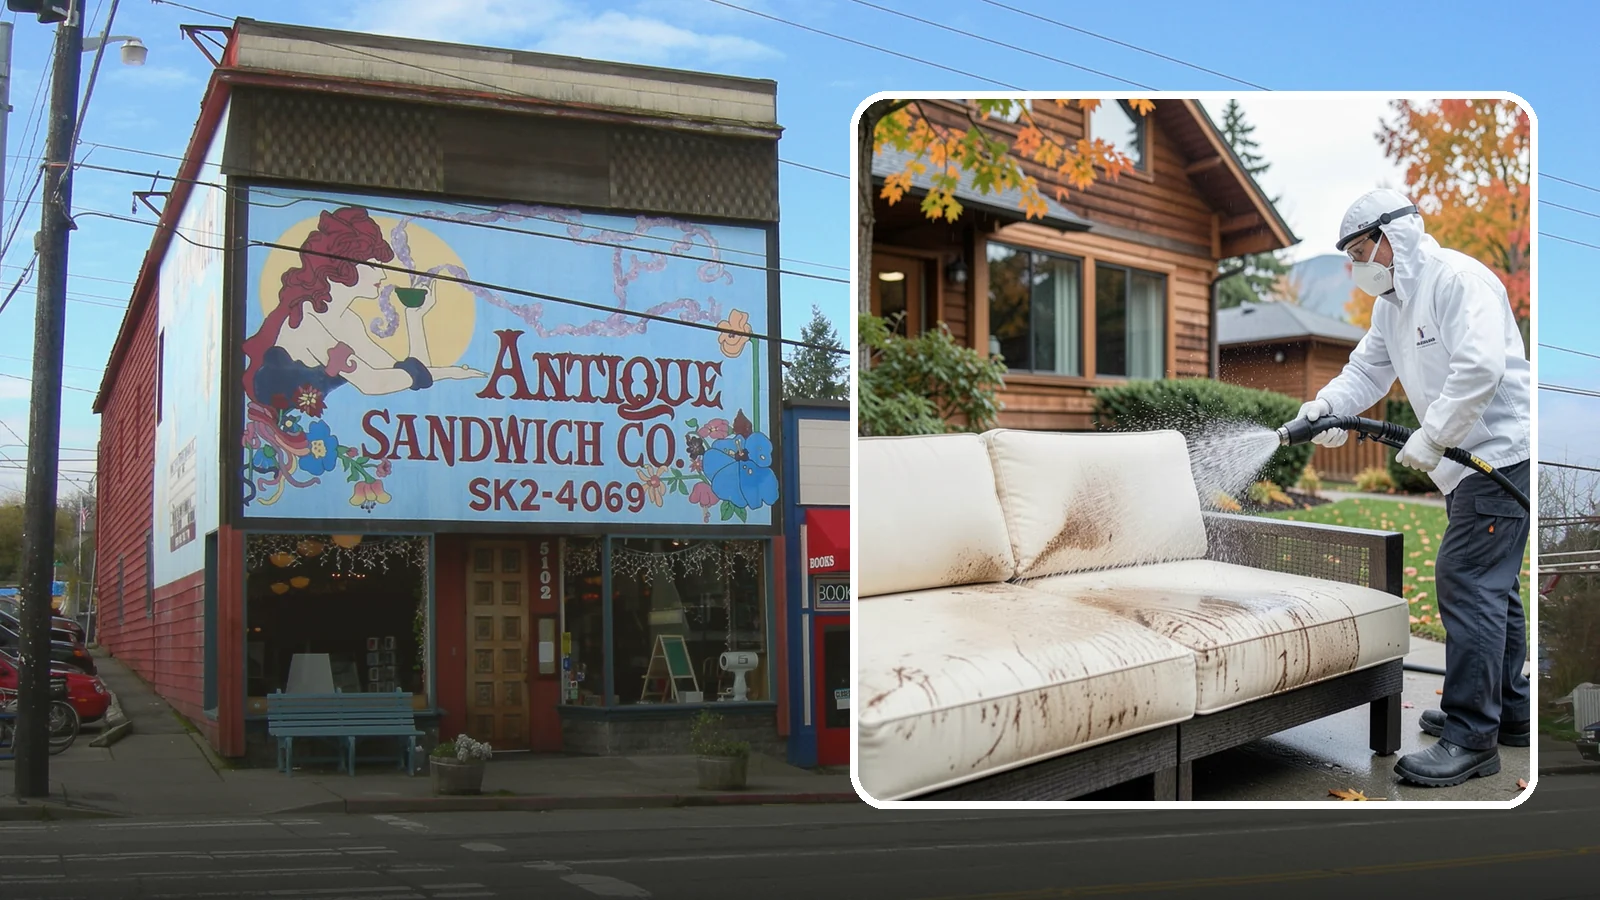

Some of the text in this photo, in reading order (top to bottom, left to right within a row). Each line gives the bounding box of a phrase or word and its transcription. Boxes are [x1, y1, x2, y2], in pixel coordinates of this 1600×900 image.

[476, 329, 723, 420] ANTIQUE
[361, 408, 685, 469] SANDWICH CO.
[468, 477, 646, 512] SK2-4069
[540, 541, 552, 600] 5102
[809, 555, 835, 569] BOOKS
